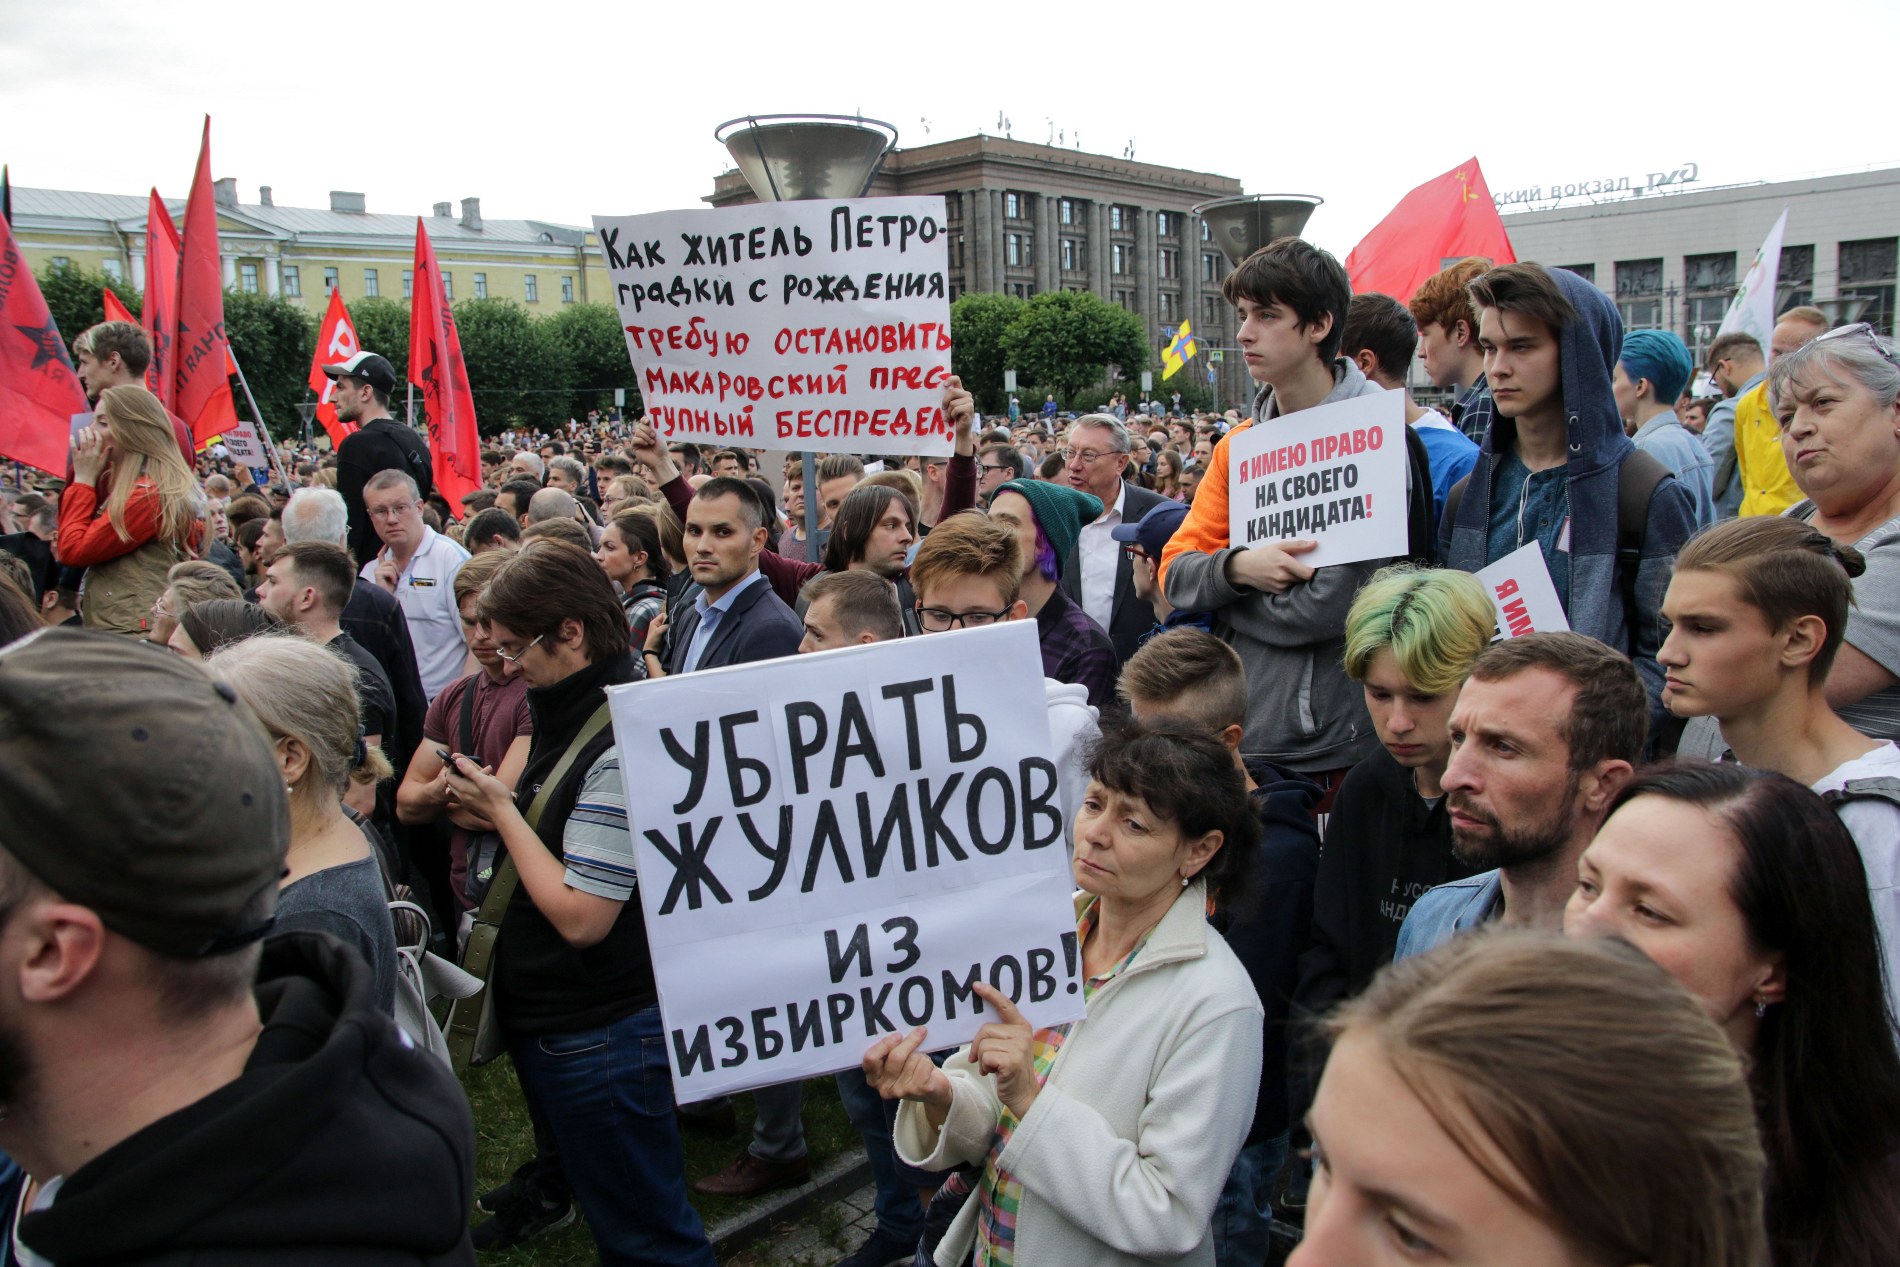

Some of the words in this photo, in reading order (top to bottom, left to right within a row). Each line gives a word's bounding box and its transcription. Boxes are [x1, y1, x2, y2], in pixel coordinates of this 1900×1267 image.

[1551, 176, 1630, 198] вокзал
[681, 224, 812, 266] ЖИТЕЛЬ
[830, 205, 948, 254] ПЕТРО-
[784, 272, 944, 305] РОЖДЕНИЯ
[625, 316, 749, 357] ТРЕБУЮ
[774, 322, 952, 355] ОСТАНОВИТЬ
[646, 364, 847, 402] МАКАРОВСКИЙ
[648, 404, 754, 437] ТУПНЫЙ
[1239, 460, 1249, 484] Я
[1251, 442, 1307, 478] ИМЕЮ
[1311, 425, 1384, 463] ПРАВО
[1255, 481, 1278, 509] НА
[1282, 463, 1359, 502] СВОЕГО
[1247, 494, 1373, 543] КАНДИДАТА!
[1495, 578, 1519, 599] Я
[659, 674, 988, 815] УБРАТЬ
[643, 756, 1063, 916] ЖУЛИКОВ
[824, 916, 921, 984] ИЗ
[671, 931, 1080, 1078] ИЗБИРКОМОВ!
